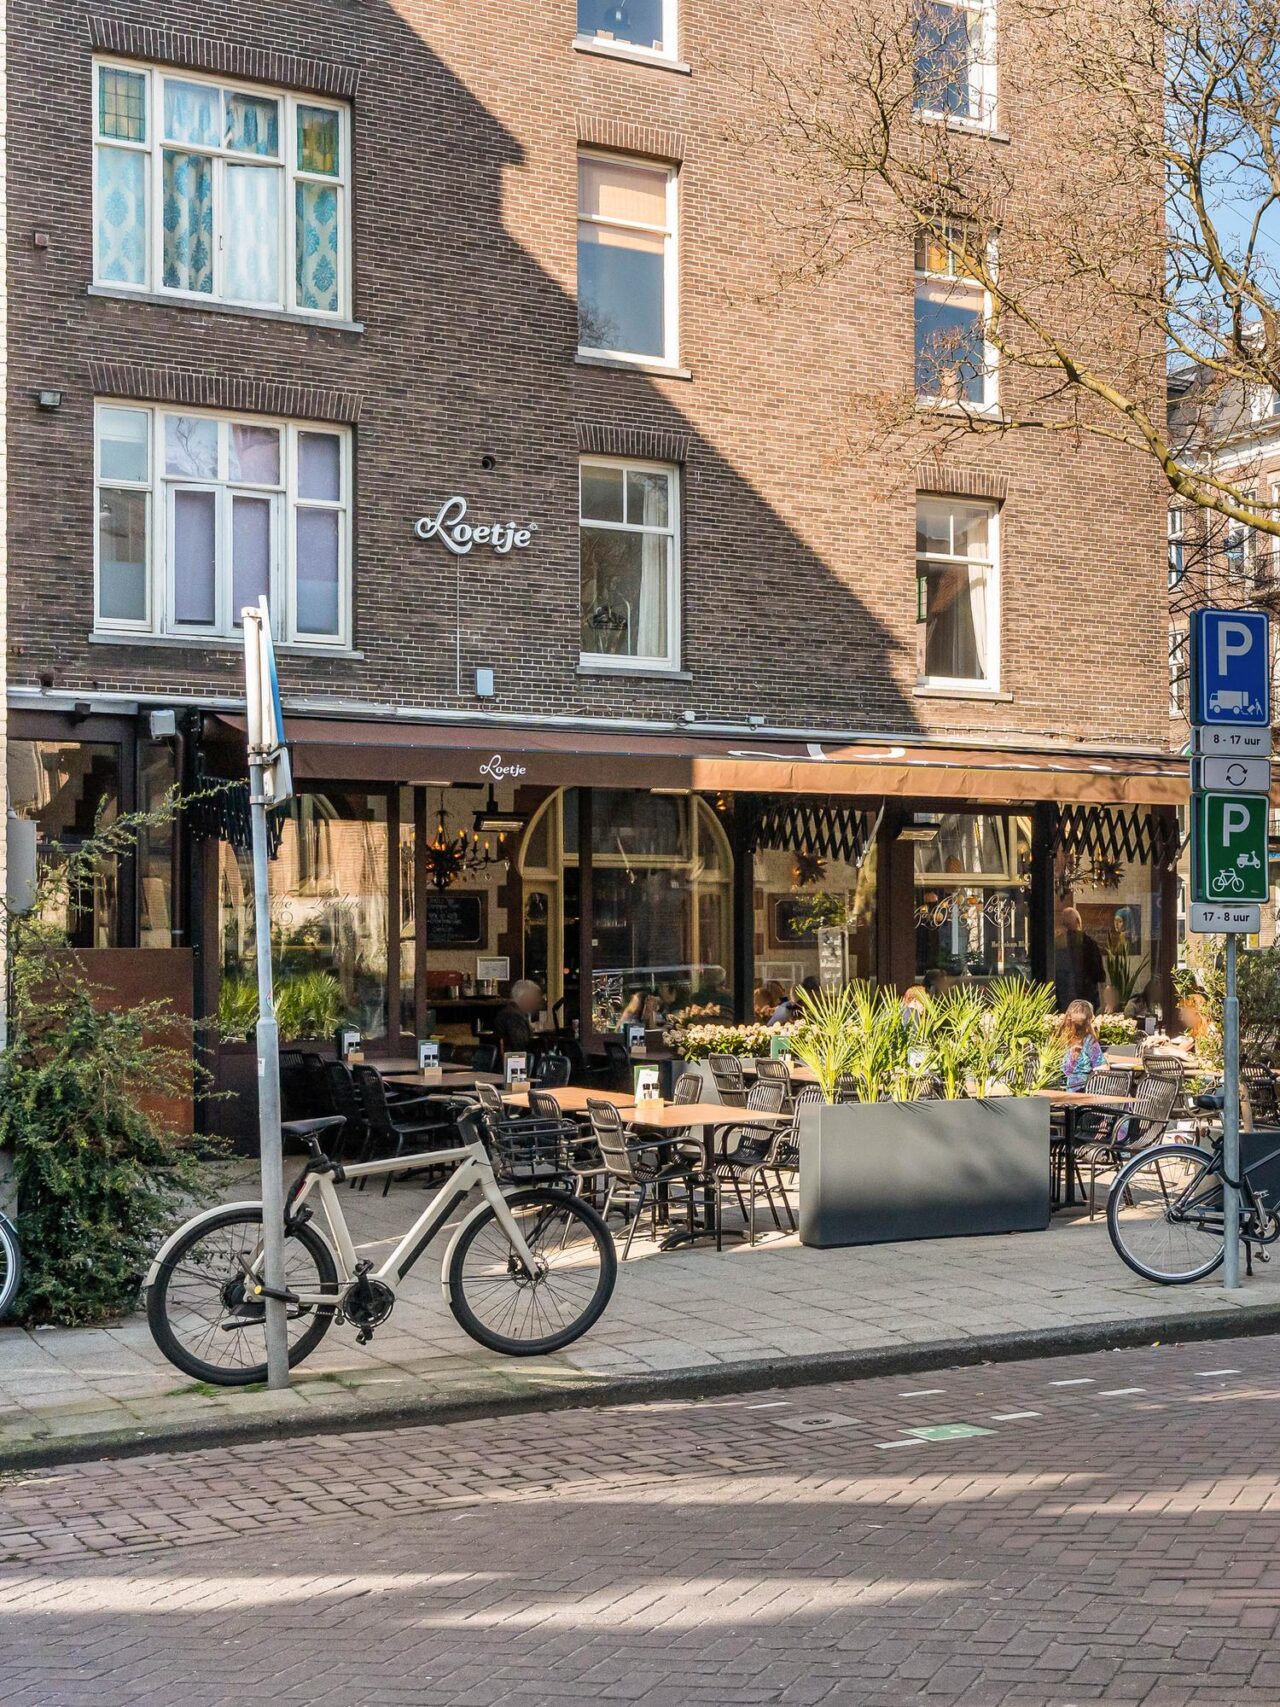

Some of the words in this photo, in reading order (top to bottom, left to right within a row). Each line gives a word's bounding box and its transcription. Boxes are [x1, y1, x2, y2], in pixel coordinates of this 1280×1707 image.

[414, 496, 532, 555] Loetje
[1217, 620, 1253, 676] P
[1213, 734, 1219, 744] 8
[1230, 734, 1241, 744] 17
[1244, 737, 1261, 746] uur
[479, 754, 527, 780] Loetje
[1222, 803, 1251, 847] P
[1202, 912, 1215, 922] 17
[1223, 912, 1230, 921] 8
[1233, 914, 1250, 922] uur
